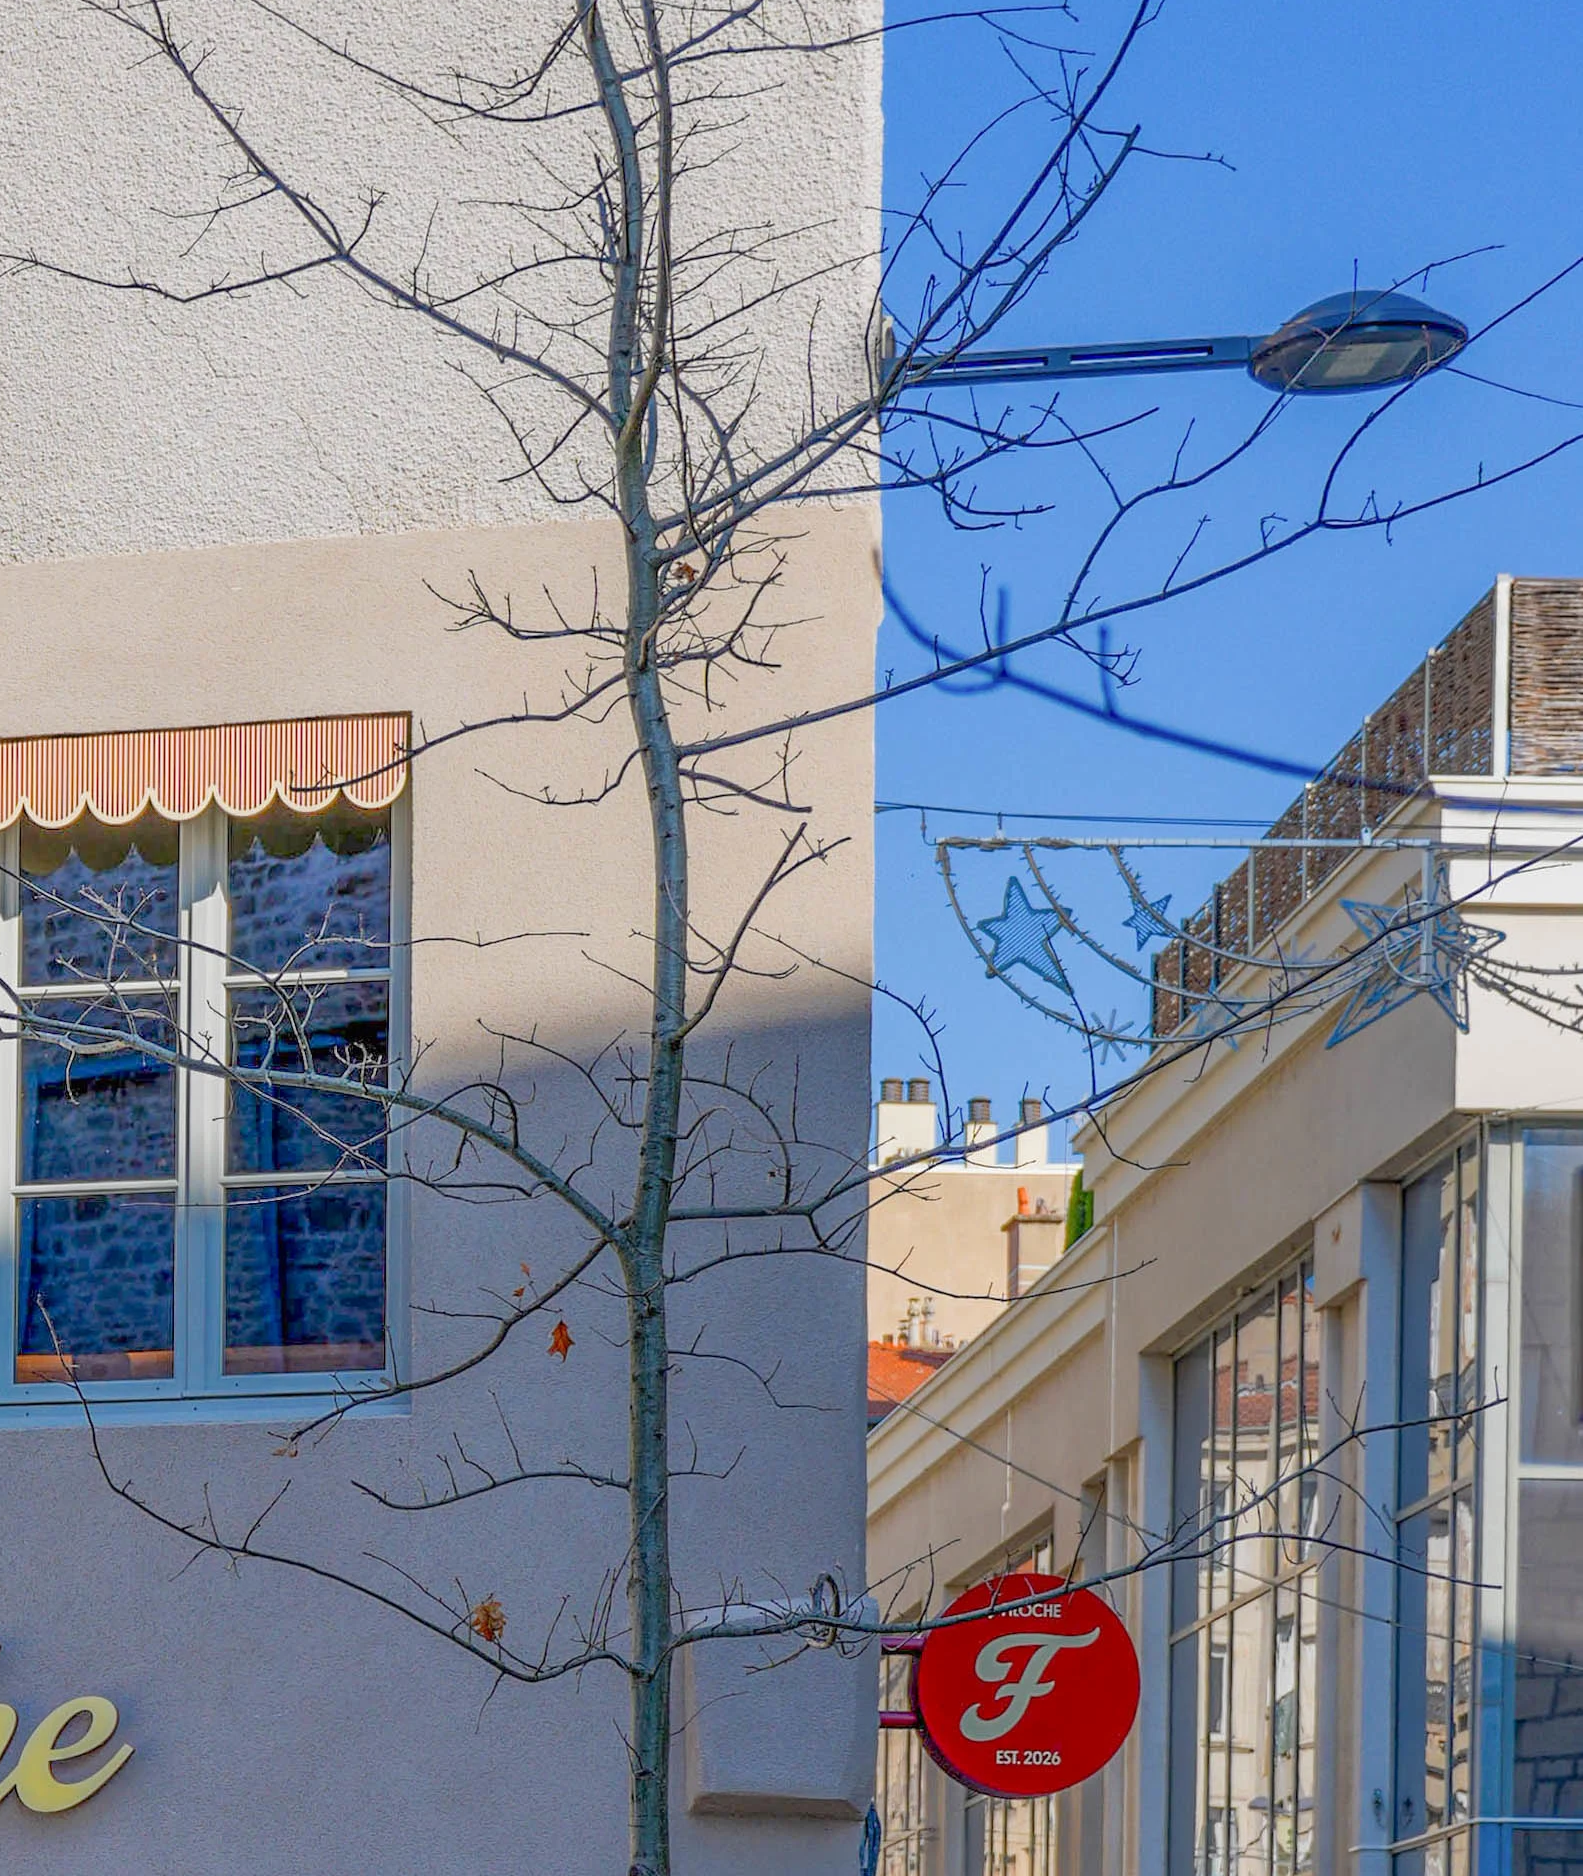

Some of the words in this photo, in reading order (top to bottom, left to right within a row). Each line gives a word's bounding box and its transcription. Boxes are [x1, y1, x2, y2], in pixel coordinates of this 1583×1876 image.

[959, 1626, 1101, 1742] F
[996, 1750, 1021, 1765] EST.
[1023, 1750, 1062, 1766] 2026
